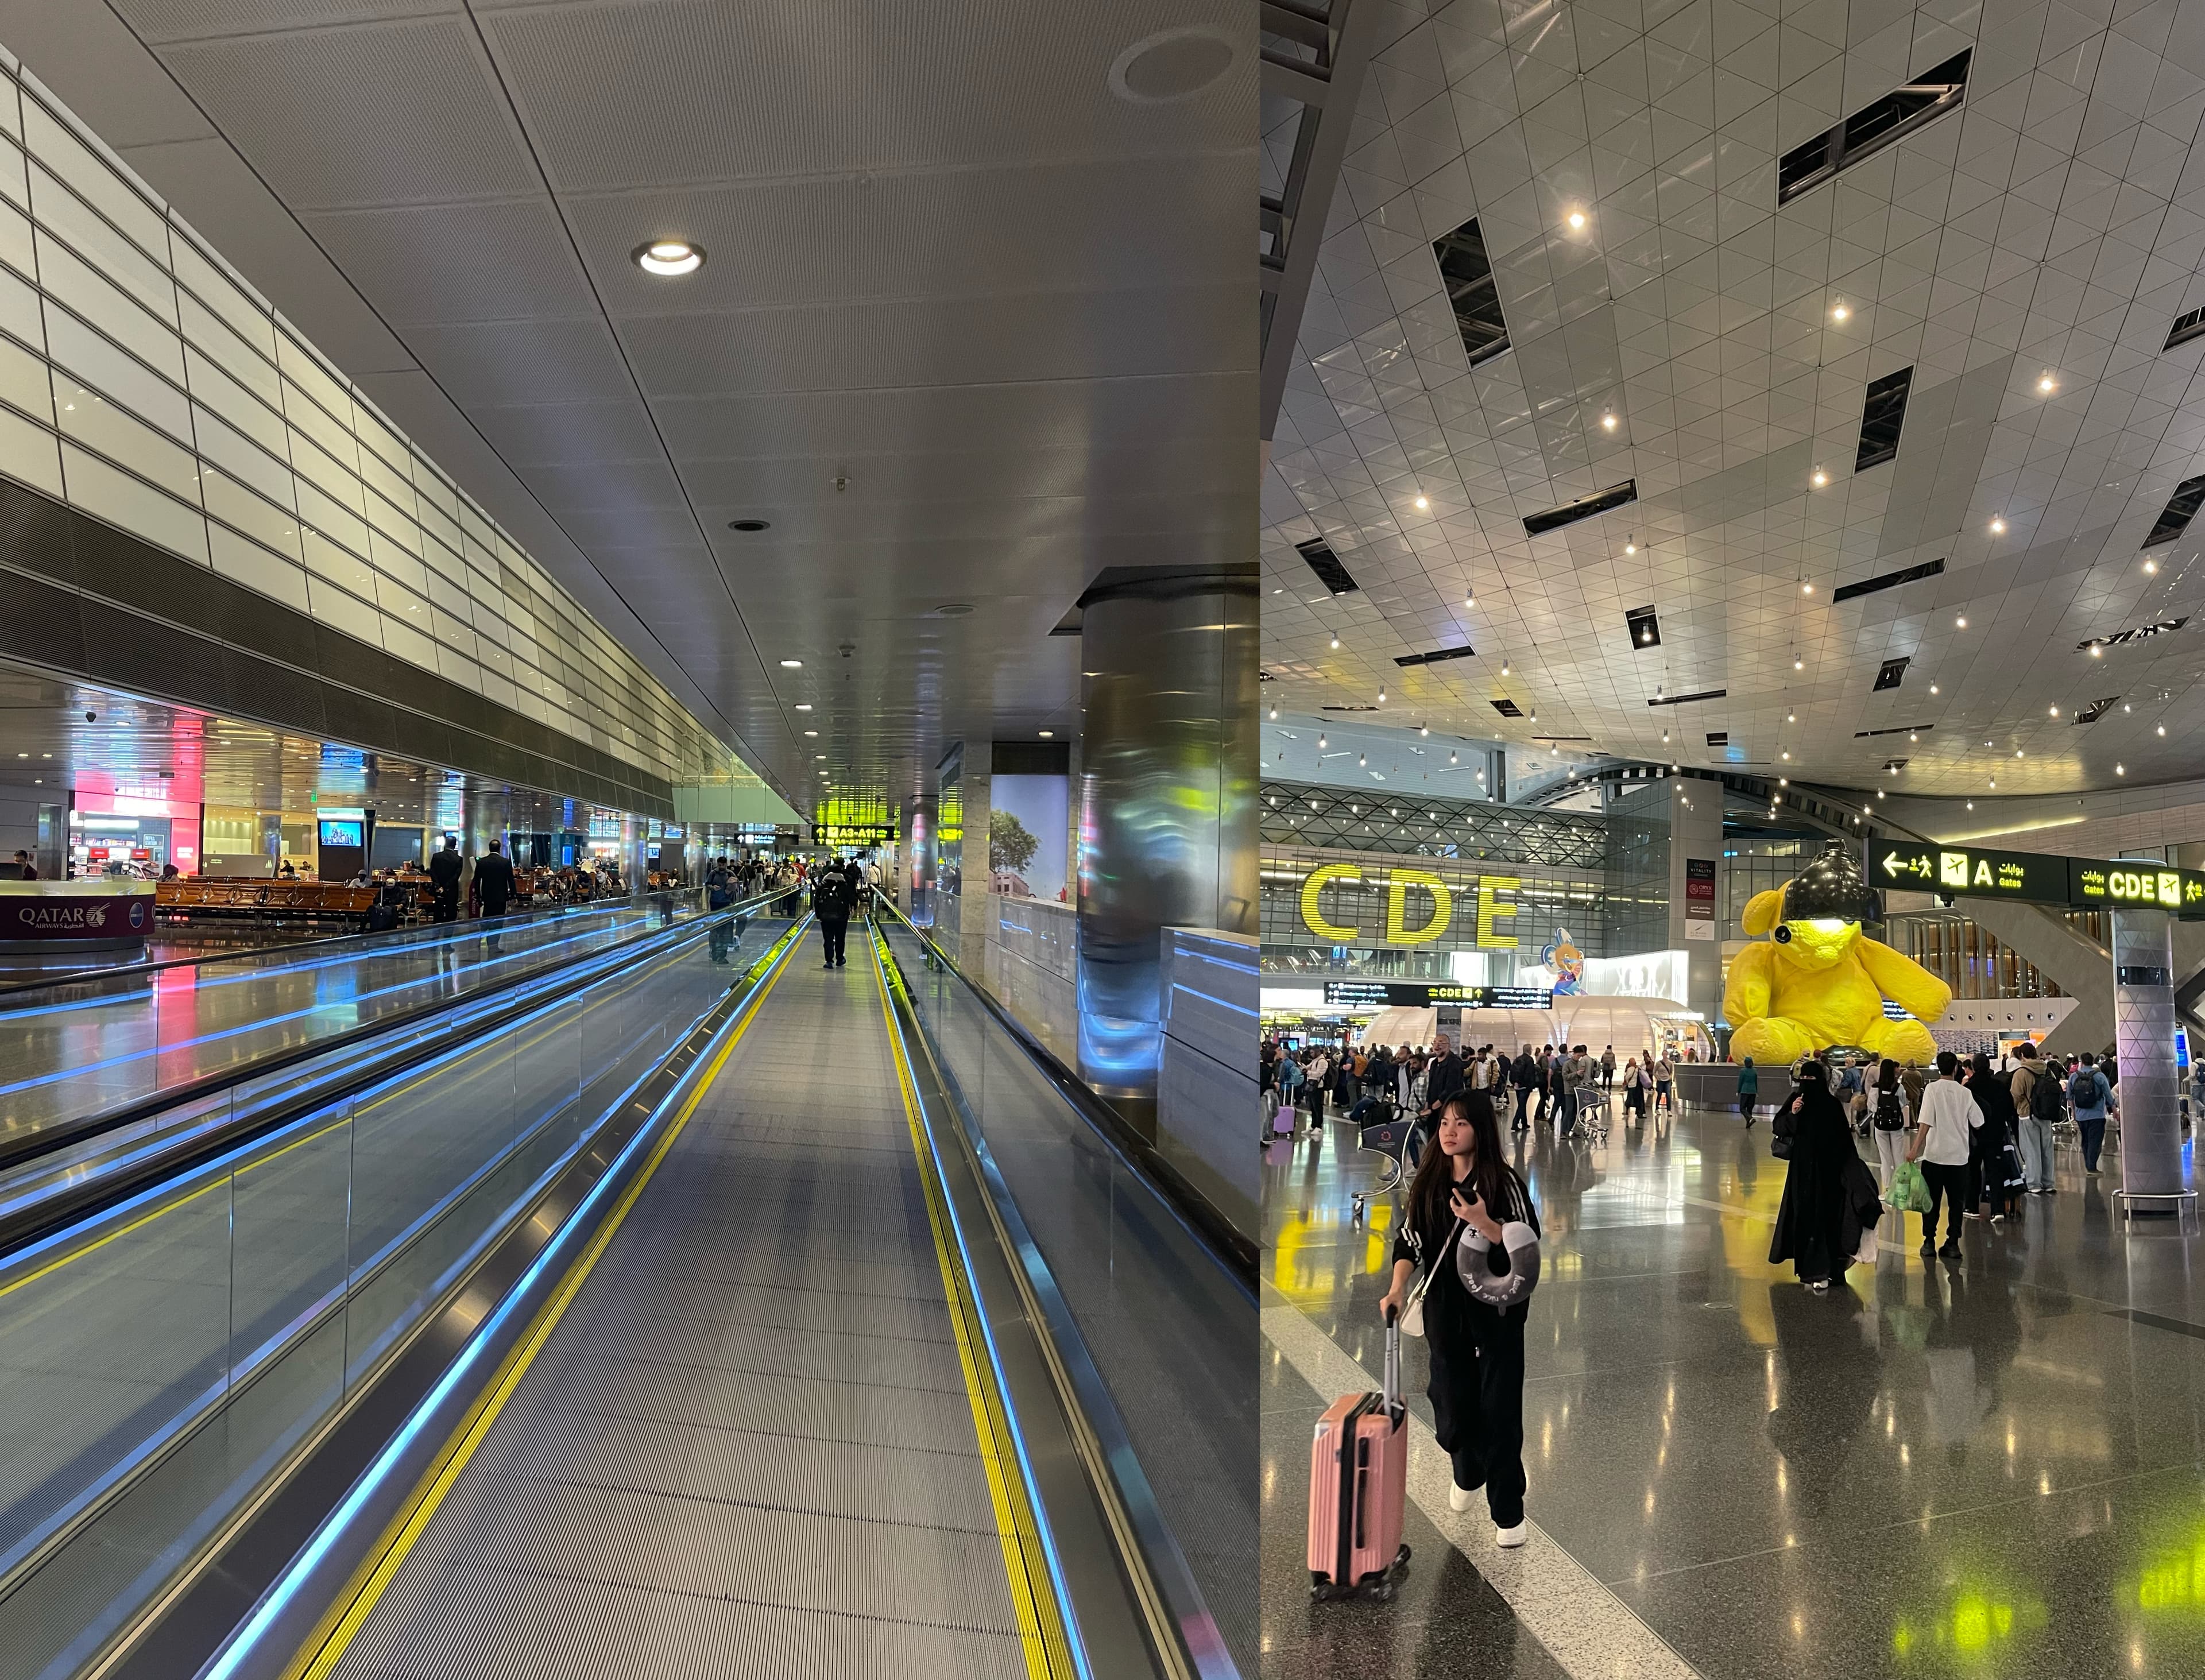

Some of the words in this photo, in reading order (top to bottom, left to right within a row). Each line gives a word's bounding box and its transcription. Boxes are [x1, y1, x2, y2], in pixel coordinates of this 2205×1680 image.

[1974, 860, 1994, 886] A
[1998, 862, 2024, 877] بوابات
[1999, 877, 2022, 888] Gates
[2081, 870, 2105, 884] بوابات
[2084, 885, 2105, 895] Gates
[2109, 872, 2155, 899] CDE
[19, 908, 84, 926] QATAR
[1438, 988, 1461, 998] CDE
[1483, 1292, 1499, 1302] nice
